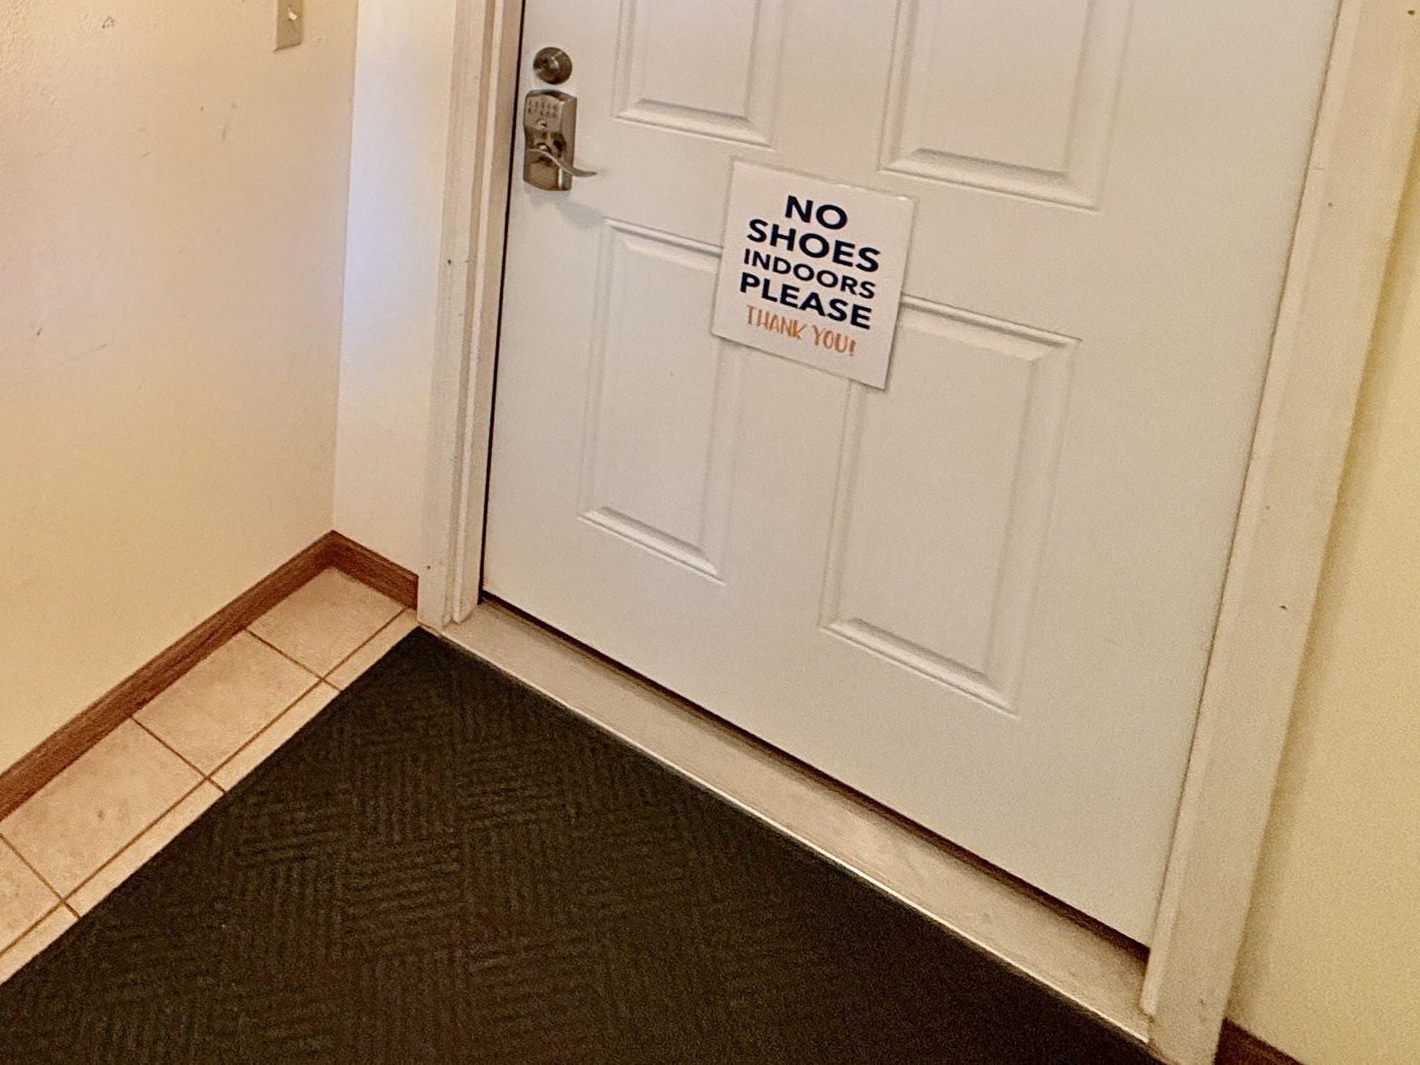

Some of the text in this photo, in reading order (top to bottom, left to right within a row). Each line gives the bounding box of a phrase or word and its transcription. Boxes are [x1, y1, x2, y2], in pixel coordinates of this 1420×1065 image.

[785, 195, 848, 230] NO
[747, 219, 880, 272] SHOES
[743, 249, 876, 299] INDOORS
[740, 272, 872, 329] PLEASE
[746, 305, 857, 356] THANK YOU!
